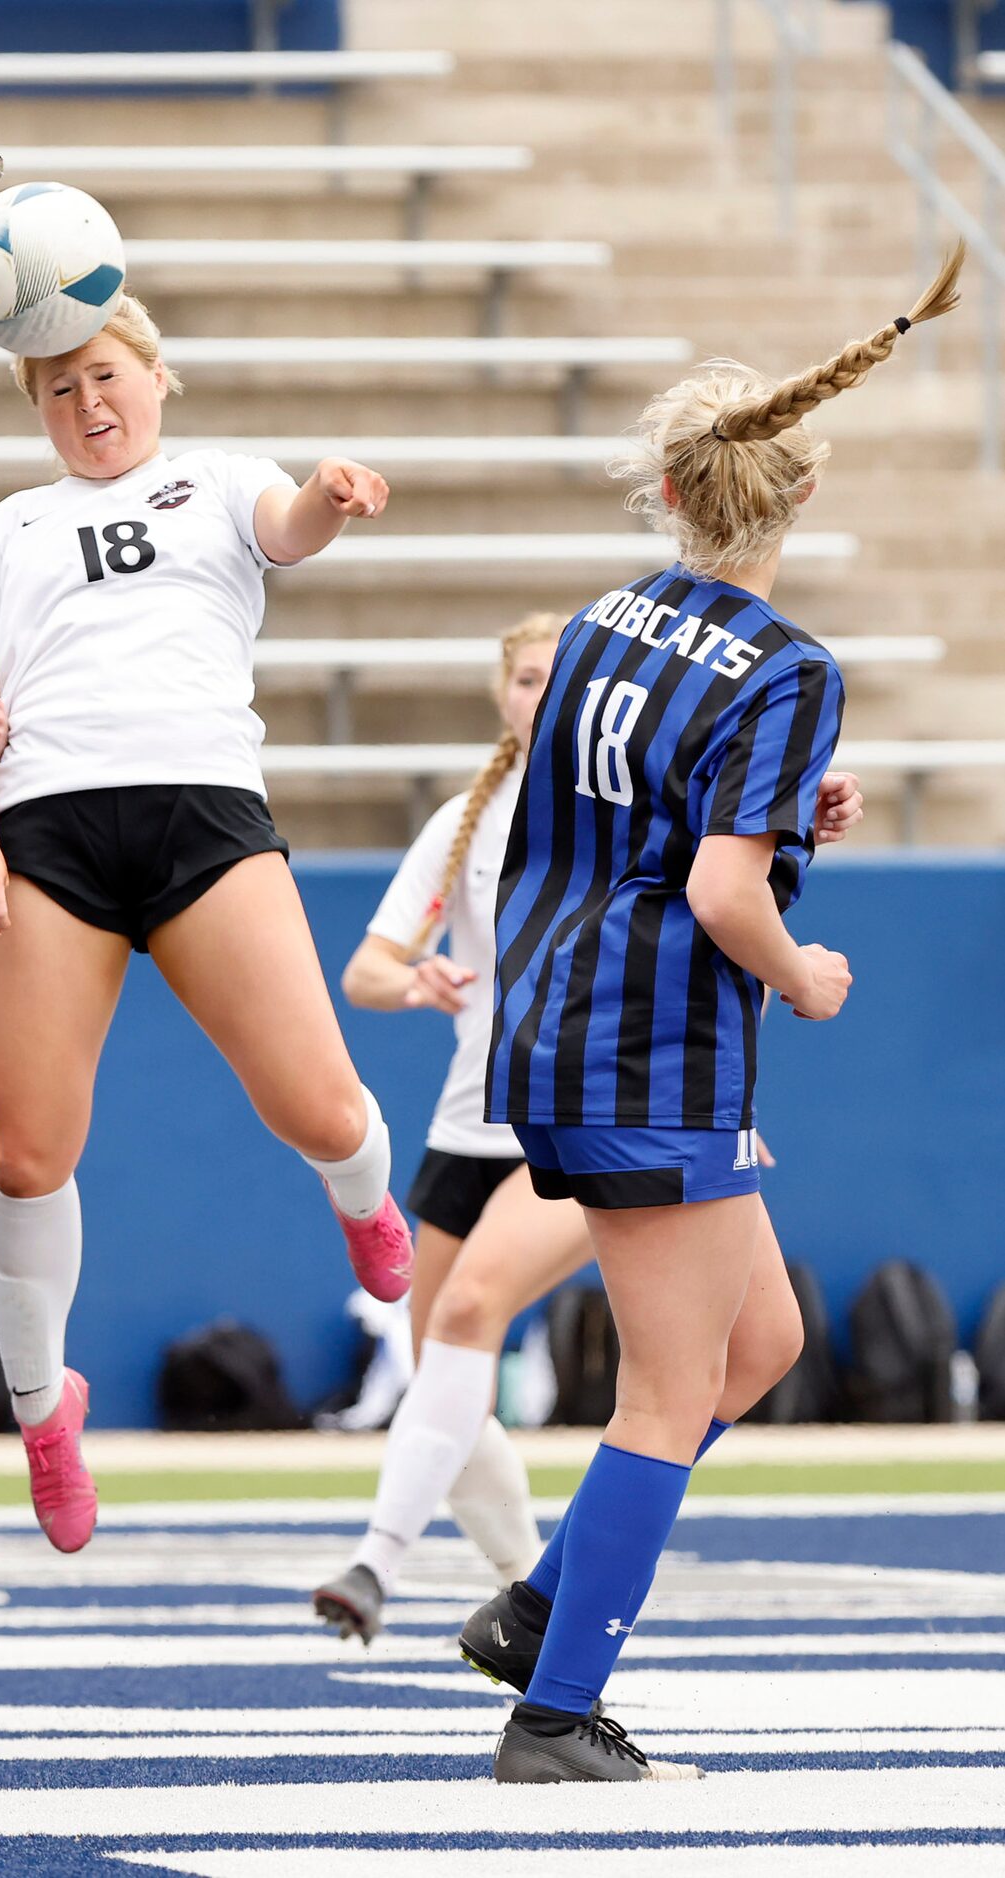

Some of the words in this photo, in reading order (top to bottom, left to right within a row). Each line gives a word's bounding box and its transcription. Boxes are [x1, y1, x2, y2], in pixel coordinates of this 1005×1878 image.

[77, 521, 156, 582] 18
[583, 590, 763, 679] BOBCATS
[575, 676, 648, 807] 18
